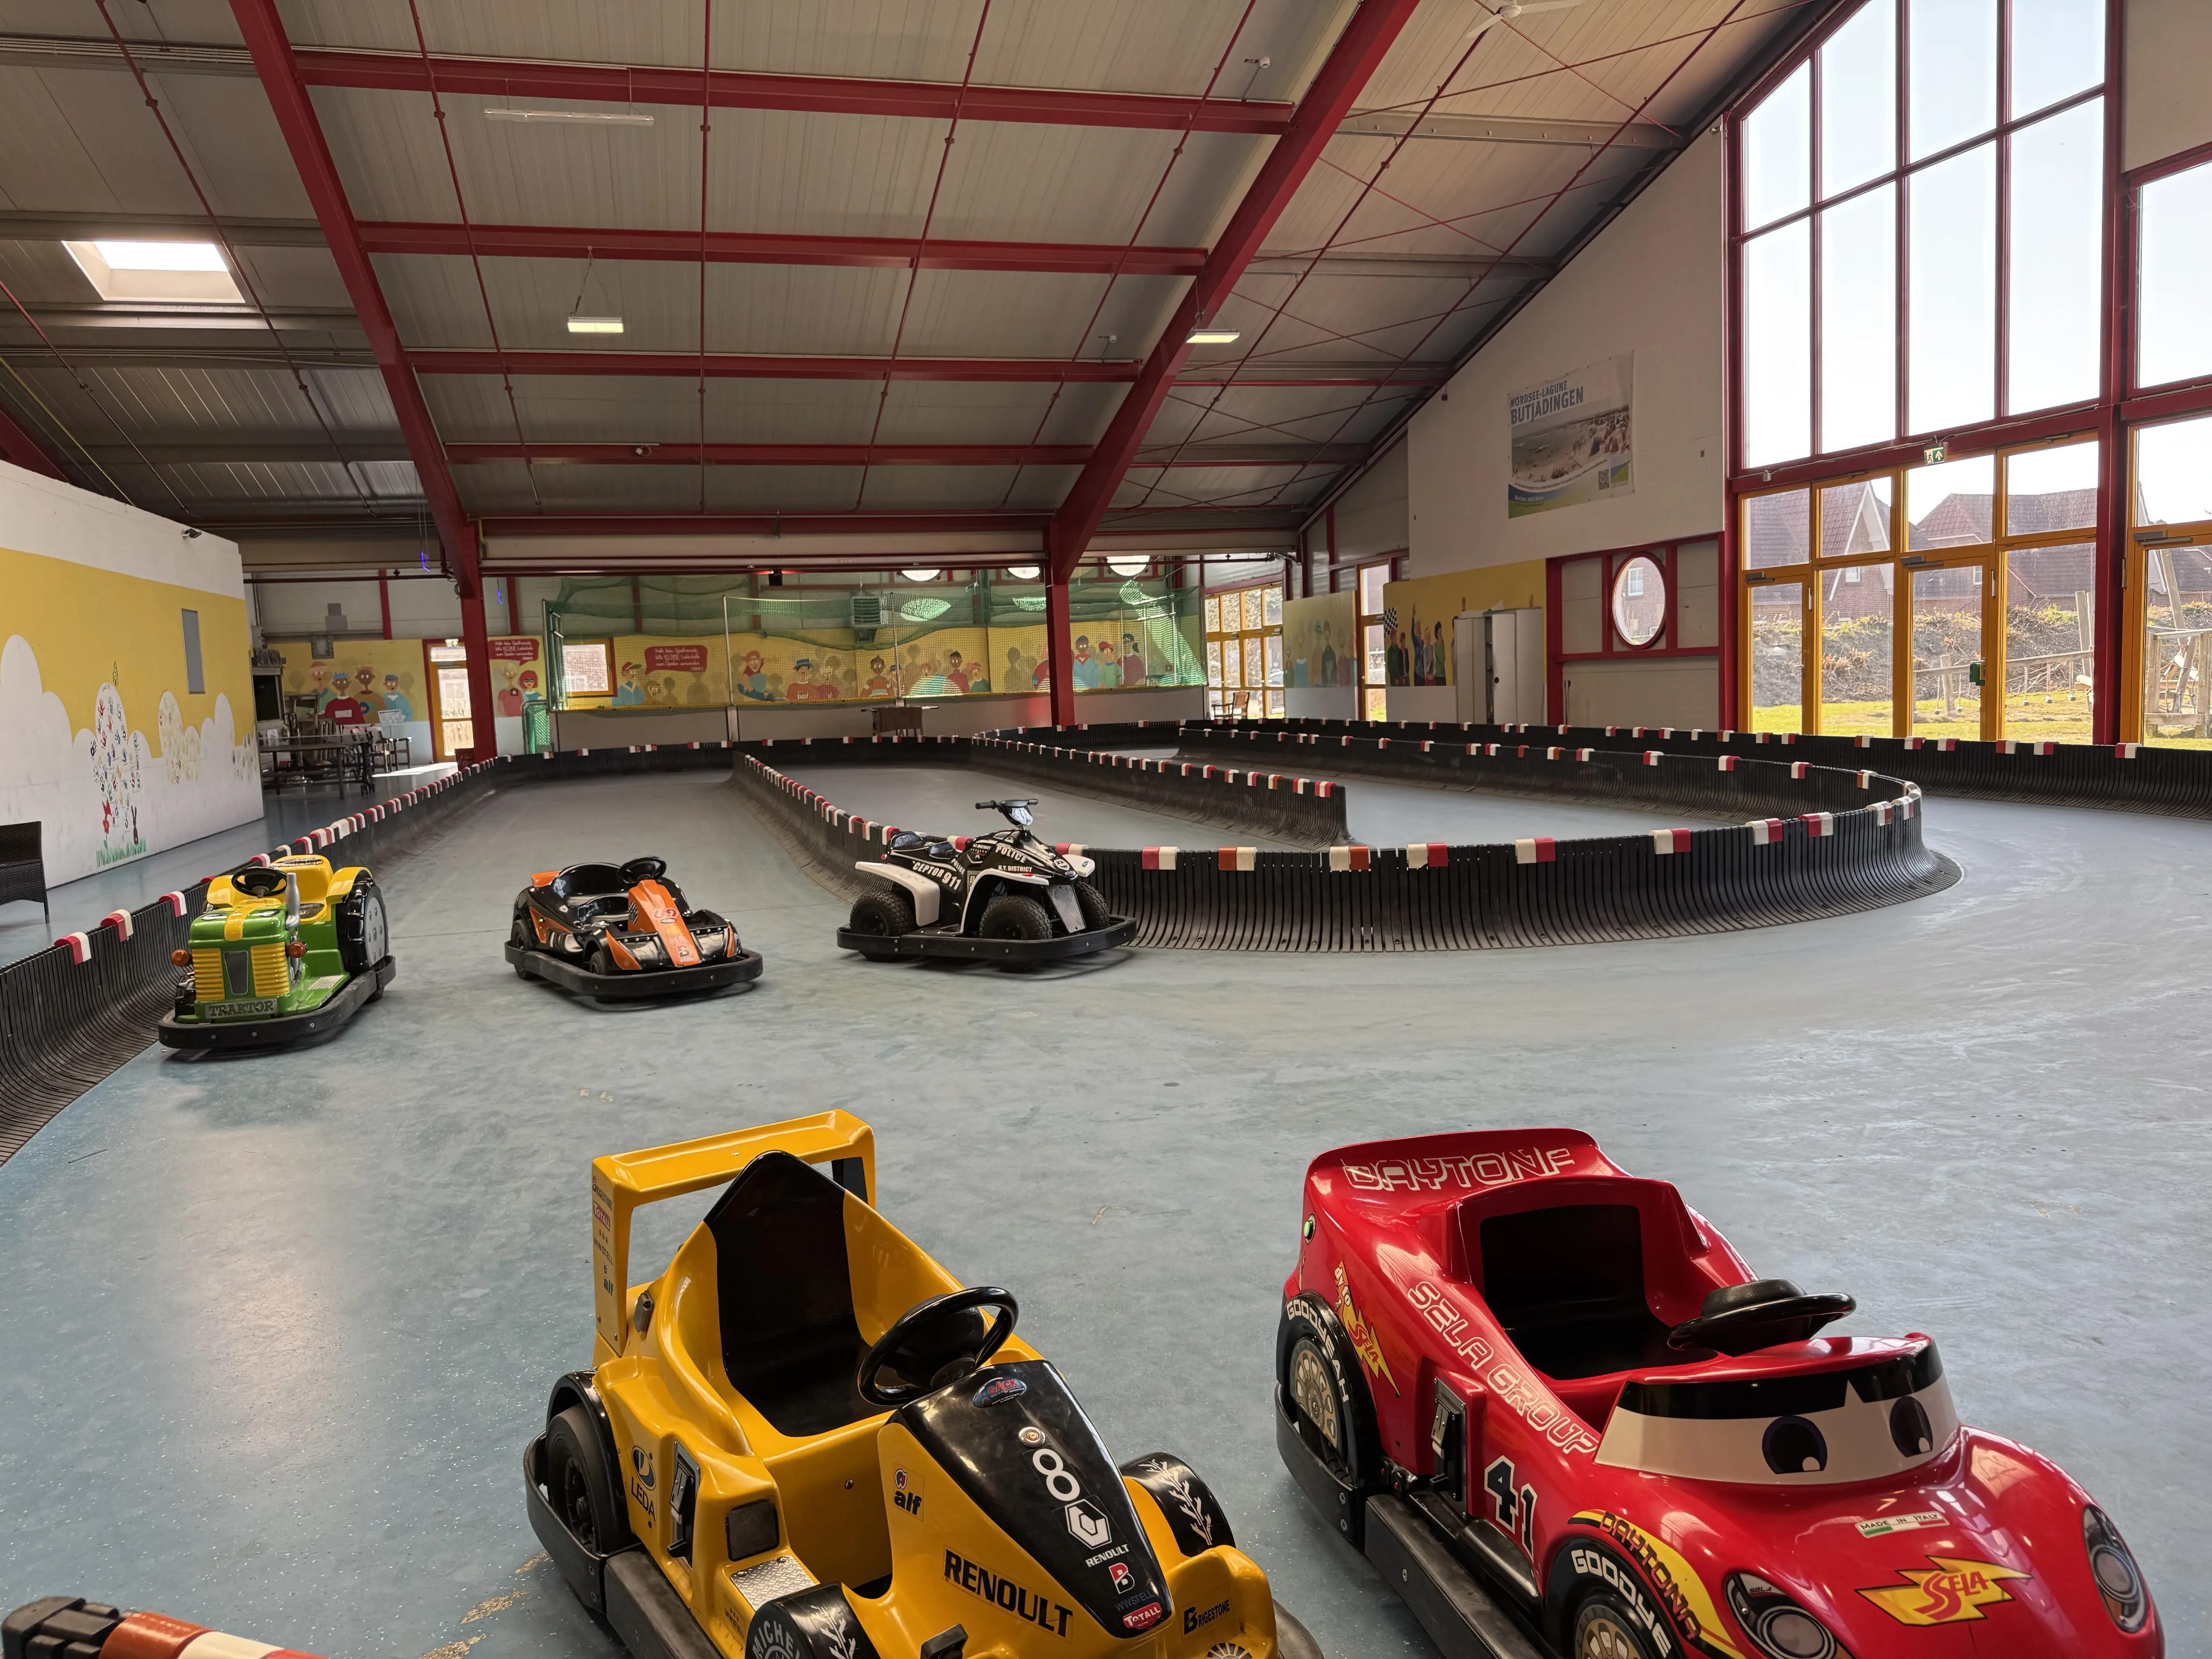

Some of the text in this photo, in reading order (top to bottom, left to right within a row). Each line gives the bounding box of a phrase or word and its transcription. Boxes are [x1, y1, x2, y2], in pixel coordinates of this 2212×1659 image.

[1510, 380, 1567, 408] NORDSEE-LAGUNE
[1511, 386, 1583, 425] BUTJADINGEN
[951, 858, 966, 875] POLICE
[995, 845, 1027, 863] POLICE
[912, 860, 945, 878] CEPTOR
[941, 872, 962, 890] 911
[209, 1000, 274, 1017] TRAKTOR
[1407, 1281, 1494, 1370] SELA
[1487, 1364, 1599, 1454] GROUP
[1032, 1448, 1080, 1501] 8
[632, 1477, 656, 1523] LEDA
[894, 1491, 922, 1515] alf
[1484, 1455, 1538, 1563] 41
[1860, 1520, 1890, 1530] MADE
[1913, 1513, 1938, 1522] ITALY
[1085, 1544, 1129, 1567] RENOULT
[1599, 1511, 1702, 1640] DAYTONA
[944, 1549, 1073, 1638] RENOULT
[1115, 1590, 1154, 1611] WWSTELL
[1912, 1571, 1989, 1621] SELA
[1184, 1599, 1230, 1635] BRIGESTONE
